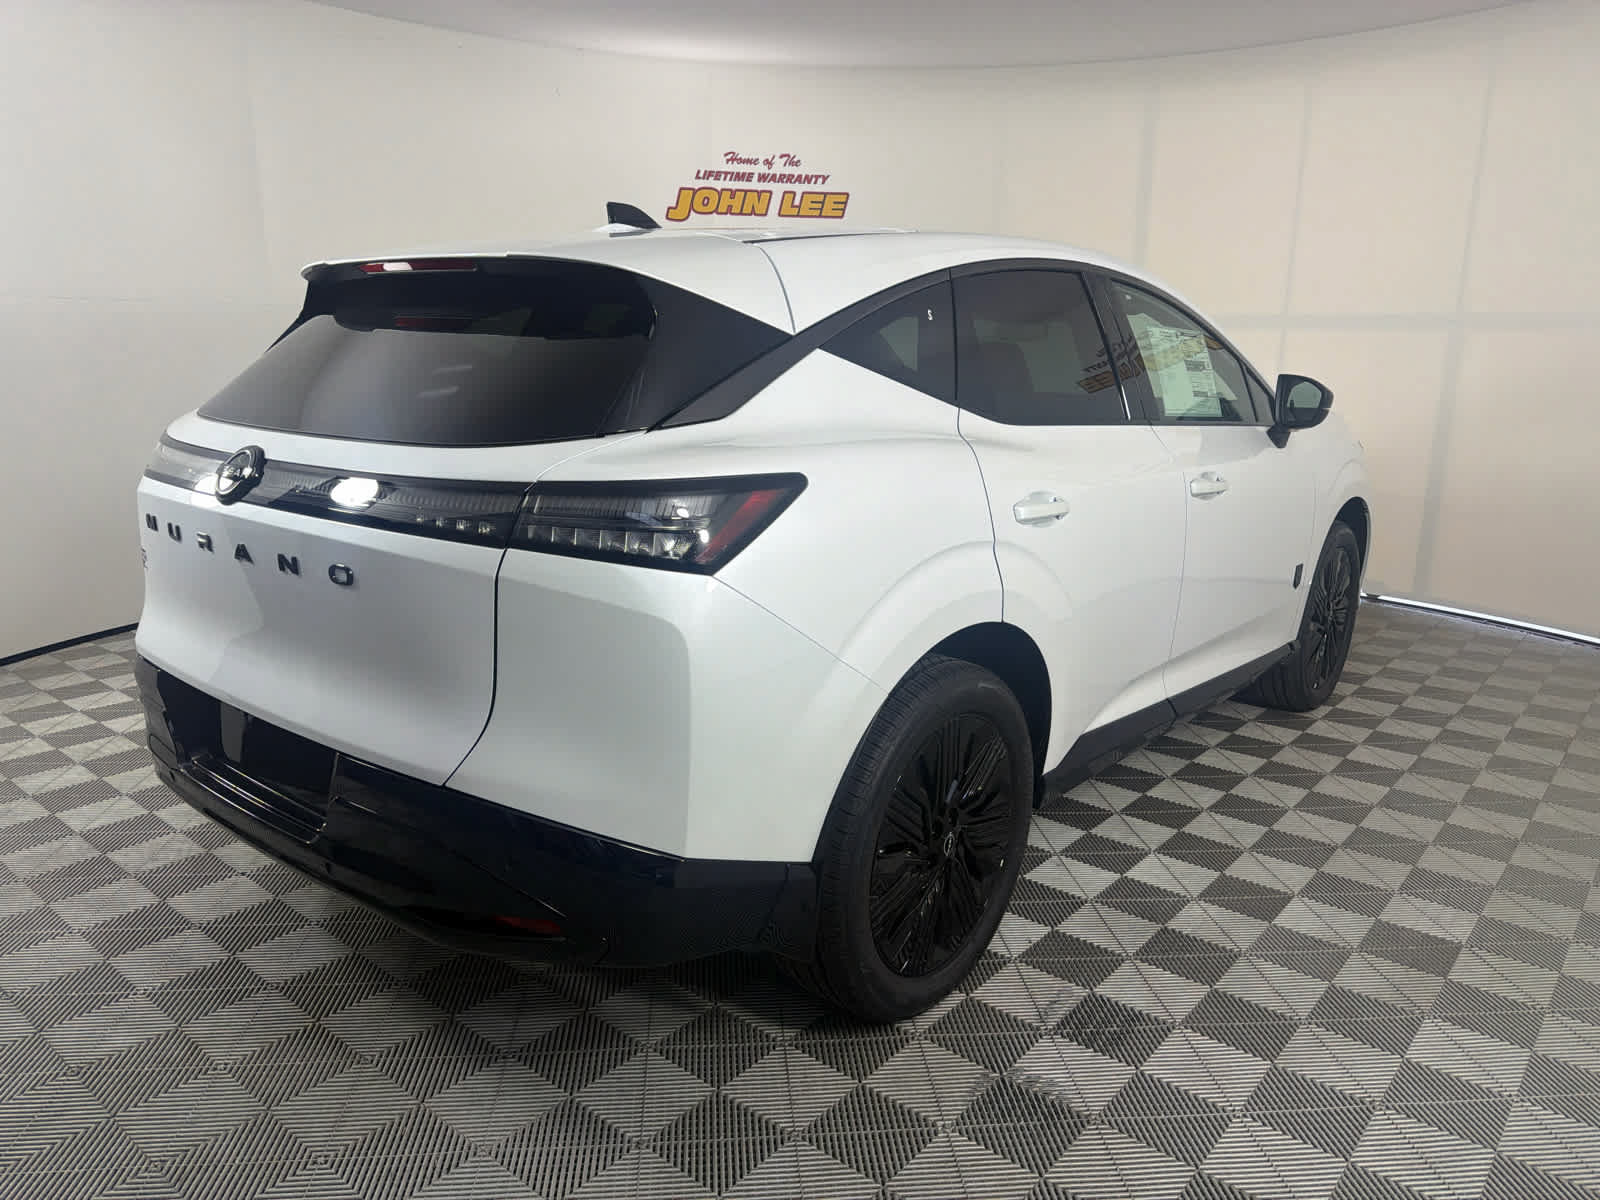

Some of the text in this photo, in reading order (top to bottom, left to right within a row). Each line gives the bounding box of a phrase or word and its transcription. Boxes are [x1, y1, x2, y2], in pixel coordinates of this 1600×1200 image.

[723, 151, 802, 170] Home of The
[695, 169, 830, 185] LIFETIME WARRANTY
[666, 186, 850, 222] JOHN LEE
[145, 513, 355, 587] MURANO
